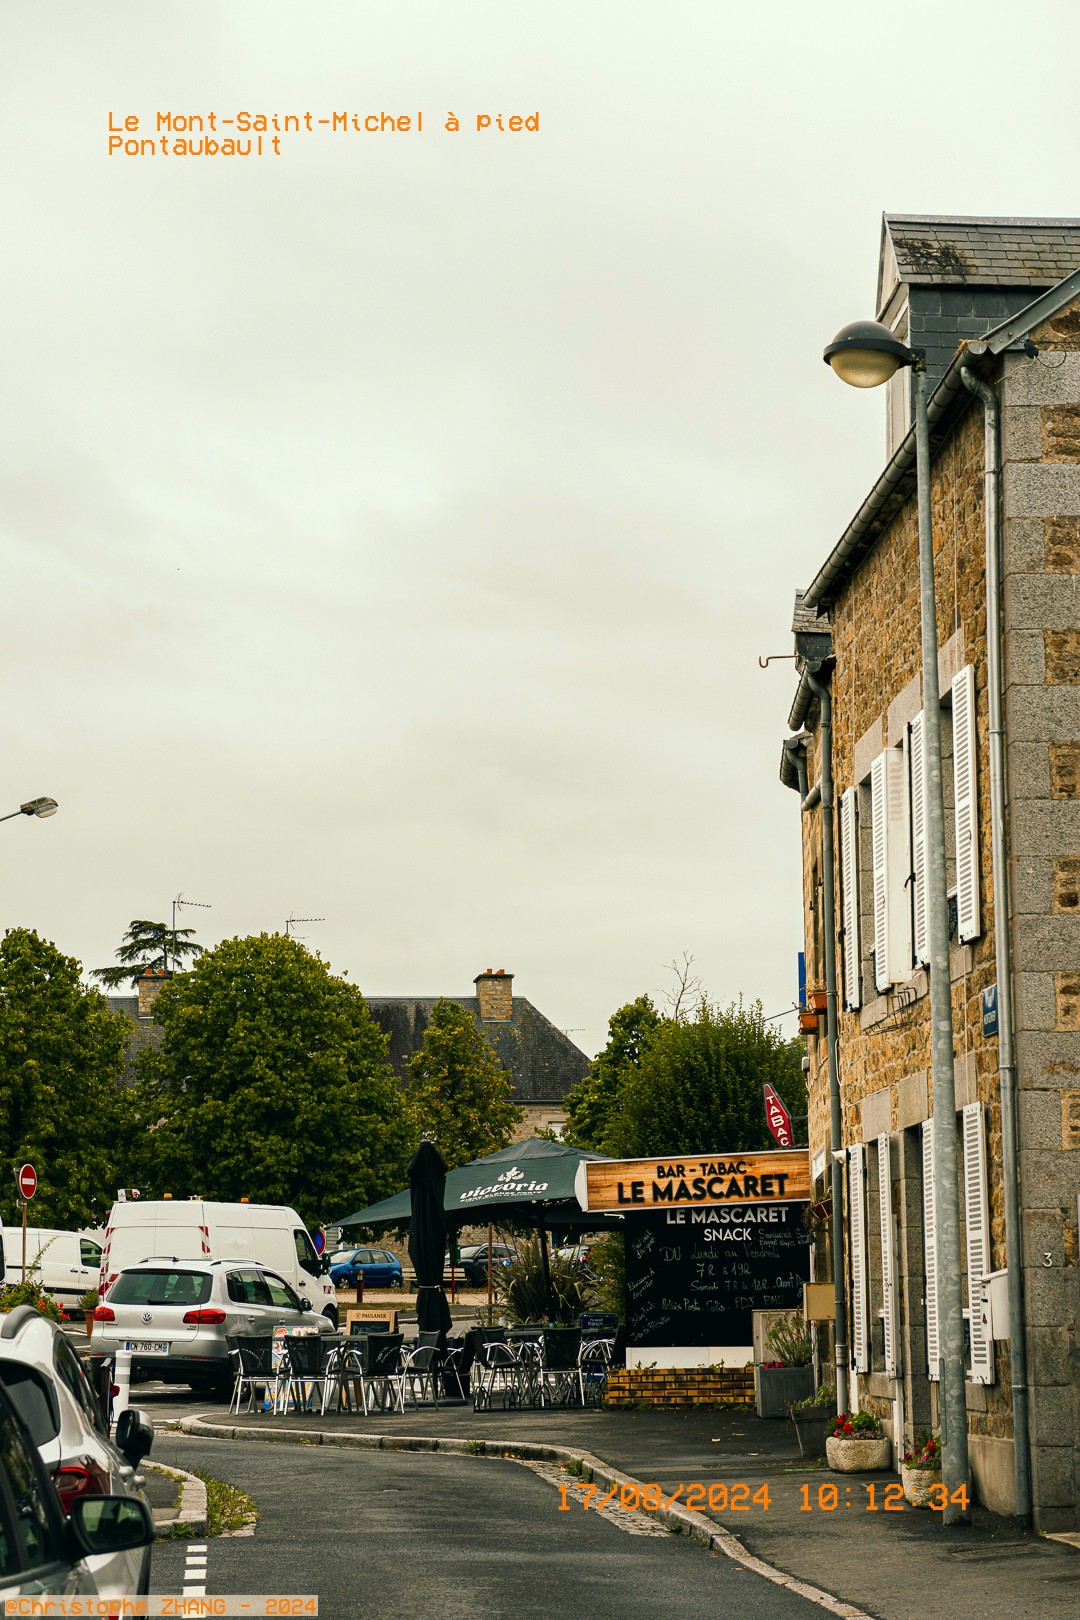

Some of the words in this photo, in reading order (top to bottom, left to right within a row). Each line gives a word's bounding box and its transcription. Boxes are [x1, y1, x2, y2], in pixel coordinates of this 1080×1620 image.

[766, 1096, 789, 1146] TABAC
[656, 1164, 686, 1179] BAR
[699, 1161, 747, 1176] TABAC
[617, 1181, 645, 1204] LE
[652, 1173, 789, 1202] MASCARET
[666, 1208, 686, 1225] LE
[691, 1206, 789, 1225] MASCARET
[703, 1227, 752, 1242] SNACK
[1043, 1252, 1053, 1267] 3
